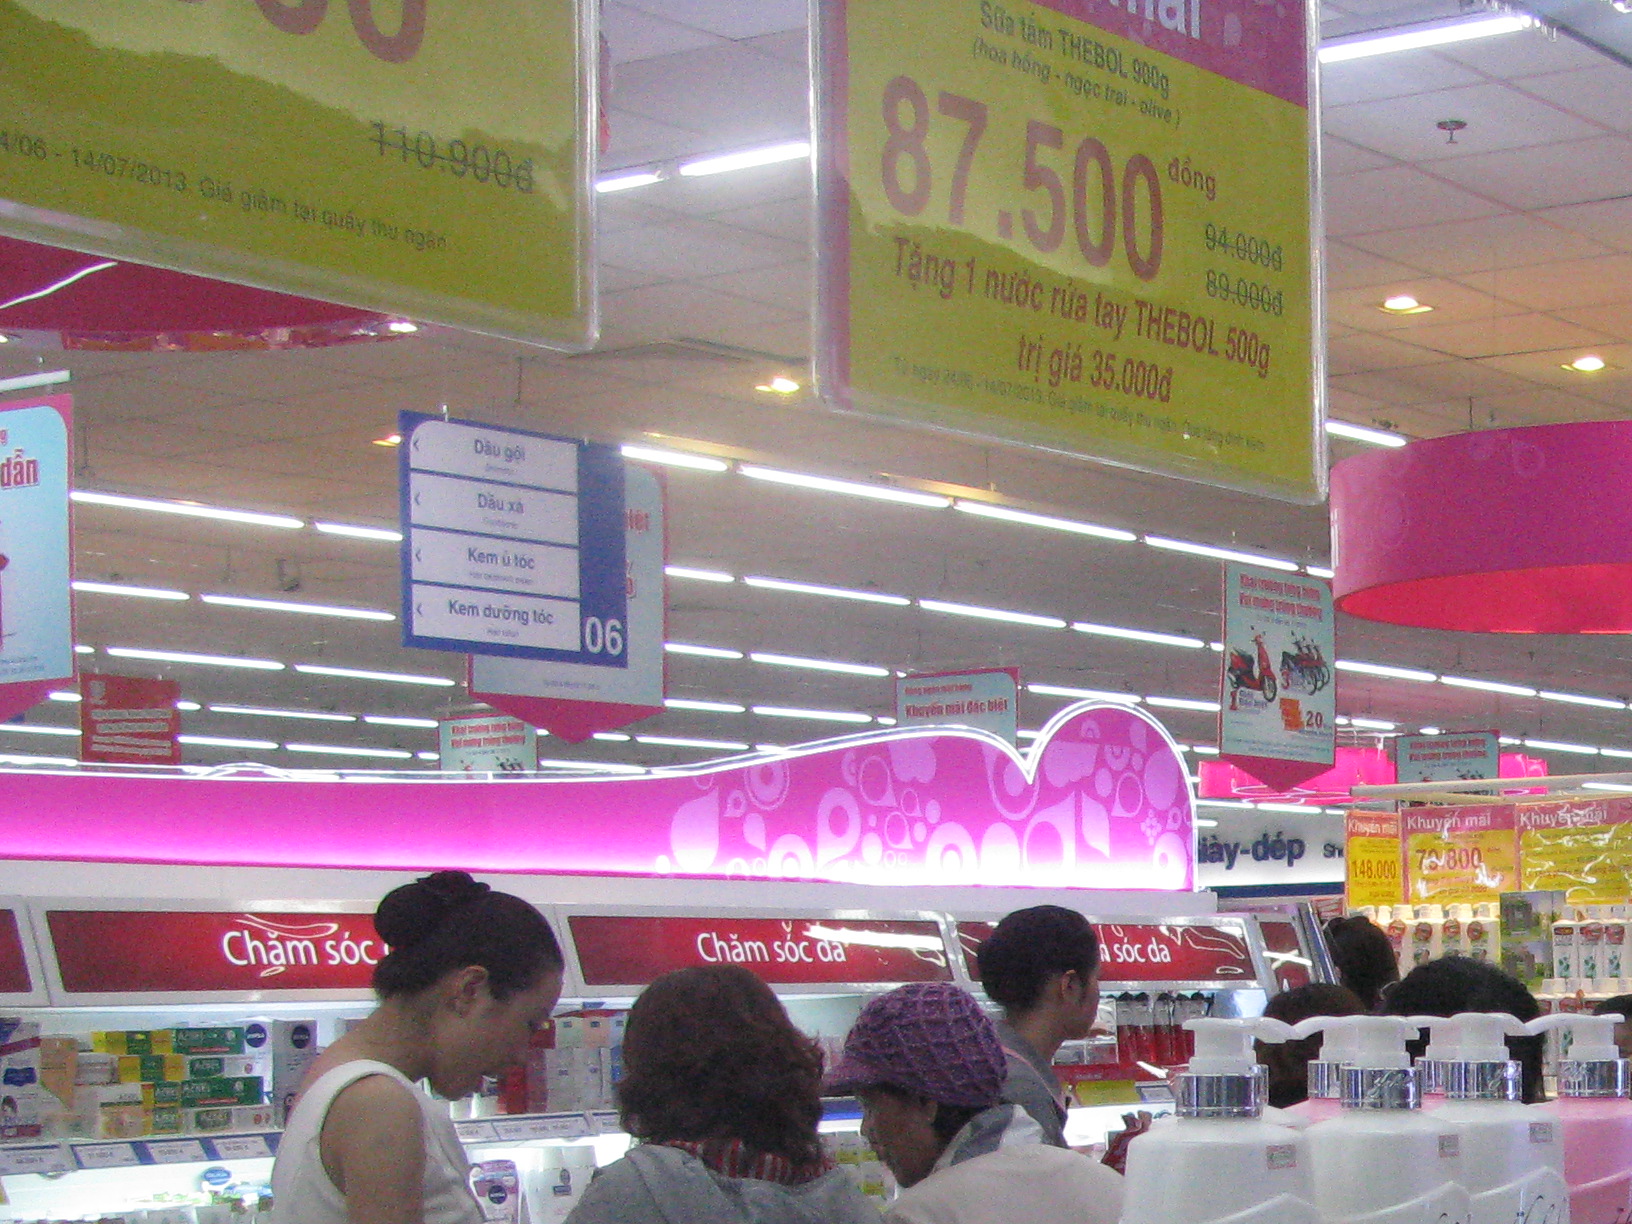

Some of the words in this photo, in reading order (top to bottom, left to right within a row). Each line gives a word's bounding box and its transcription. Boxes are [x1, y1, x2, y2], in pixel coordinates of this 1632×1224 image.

[1057, 28, 1129, 80] THEBOL
[1131, 55, 1171, 100] 900g
[71, 147, 188, 193] 14/07/2013
[881, 73, 1164, 283] 87.500
[1167, 152, 1217, 201] đồng
[892, 235, 955, 301] Tặng
[1093, 293, 1129, 341] tay
[1134, 299, 1219, 357] THEBOL
[1224, 322, 1272, 379] 500g
[1047, 344, 1083, 388] giá
[1089, 348, 1172, 404] 35.000đ
[468, 547, 498, 567] Kem
[448, 599, 480, 619] Kem
[584, 615, 624, 658] 06
[222, 929, 318, 966] Chăm
[324, 930, 378, 966] sóc
[696, 931, 770, 963] Chăm
[773, 932, 814, 963] sóc
[1113, 936, 1146, 963] sóc
[1147, 936, 1172, 963] da
